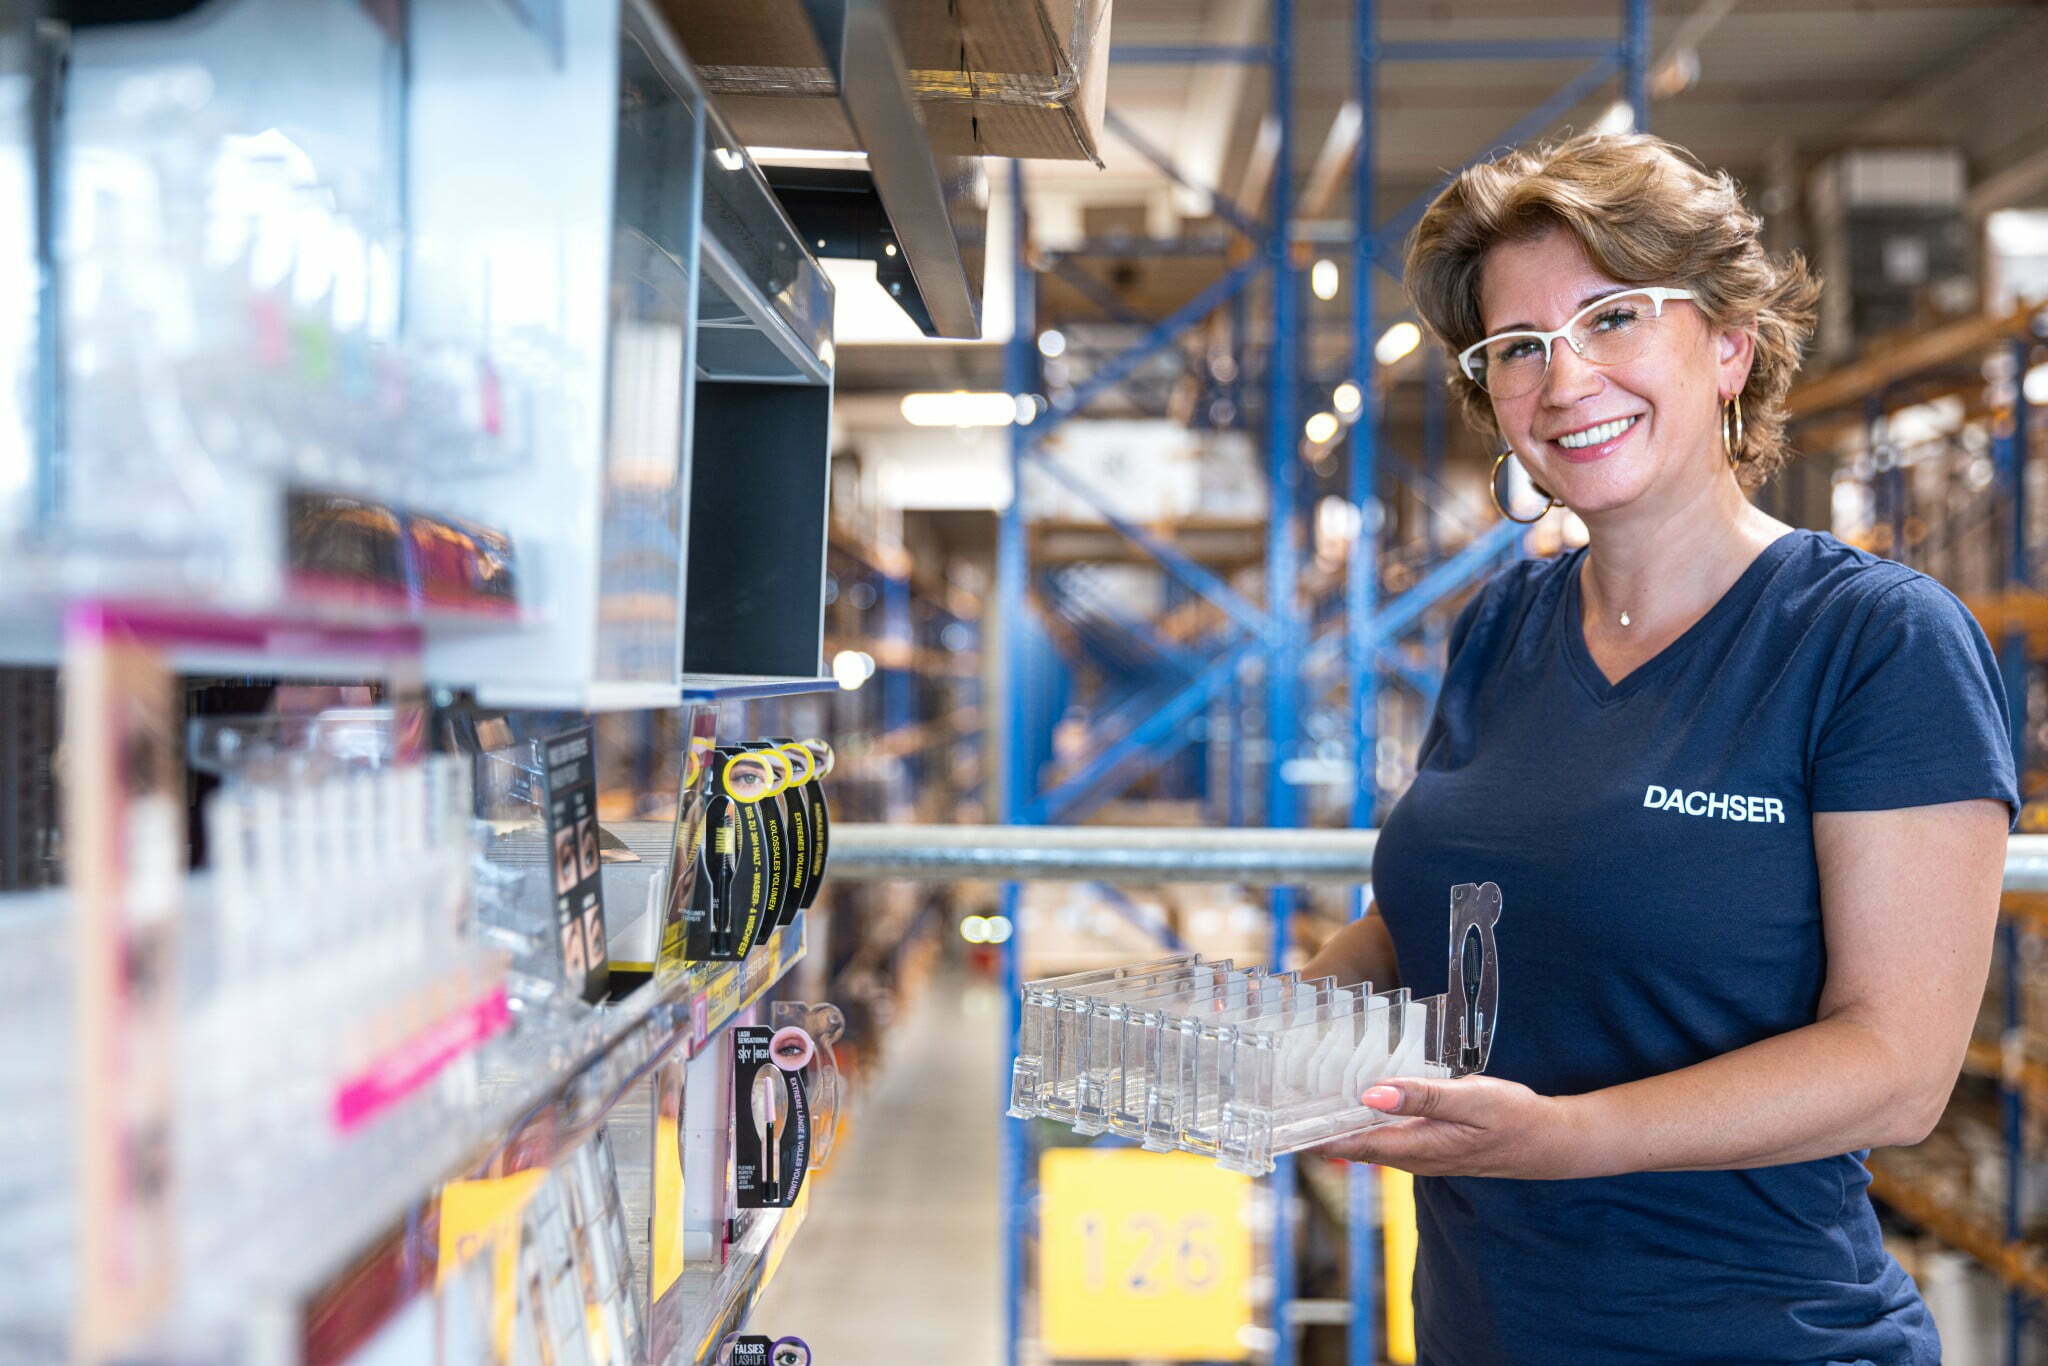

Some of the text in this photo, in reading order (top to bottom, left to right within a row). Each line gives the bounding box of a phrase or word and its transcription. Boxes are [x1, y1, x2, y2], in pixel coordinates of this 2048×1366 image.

[1643, 784, 1786, 824] DACHSER
[748, 820, 757, 831] ZU
[752, 847, 762, 866] HALT
[767, 819, 781, 911] KOLOSSALES VOLUMEN
[793, 812, 805, 888] EXTREMES VOLUMEN
[789, 1077, 803, 1110] EXTREME
[795, 1141, 804, 1167] VOLLES
[787, 1168, 801, 1201] VOLUMEN
[1075, 1211, 1223, 1295] 126
[735, 1344, 765, 1354] FALSIES
